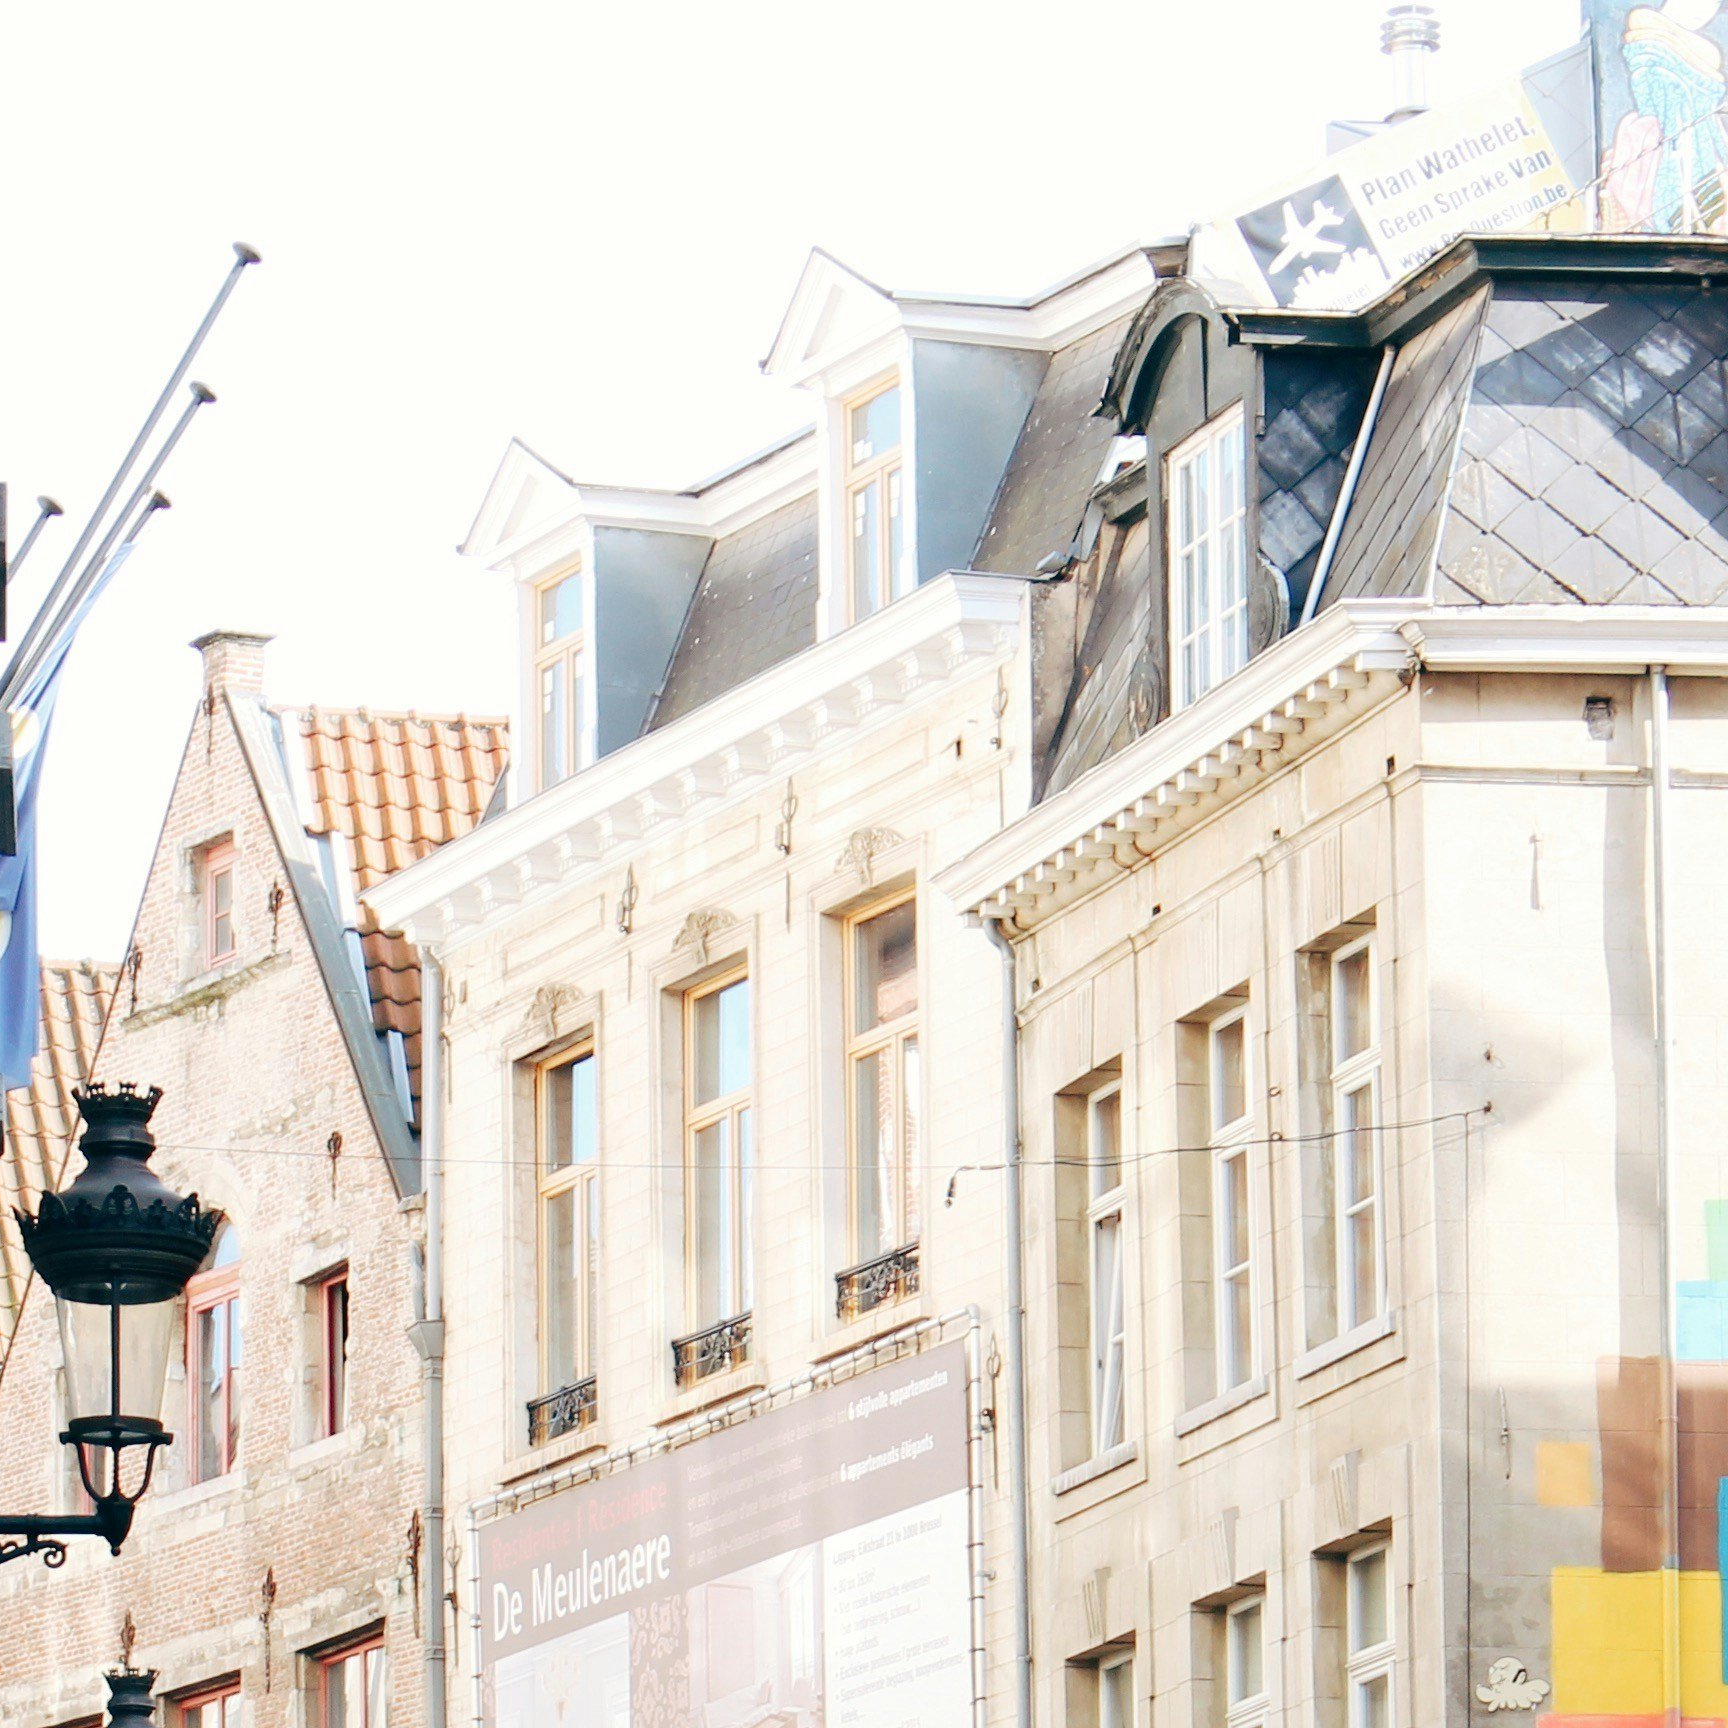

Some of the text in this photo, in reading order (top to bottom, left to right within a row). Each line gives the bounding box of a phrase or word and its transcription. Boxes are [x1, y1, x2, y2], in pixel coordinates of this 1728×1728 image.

[1361, 116, 1536, 205] Plan Wathelet,
[1379, 150, 1551, 239] Geen Sprake Van
[848, 1402, 854, 1420] 6
[889, 1369, 948, 1408] appartementen
[840, 1463, 847, 1482] 6
[848, 1446, 899, 1482] appartements
[493, 1582, 523, 1642] De
[531, 1533, 671, 1627] Meulenaere
